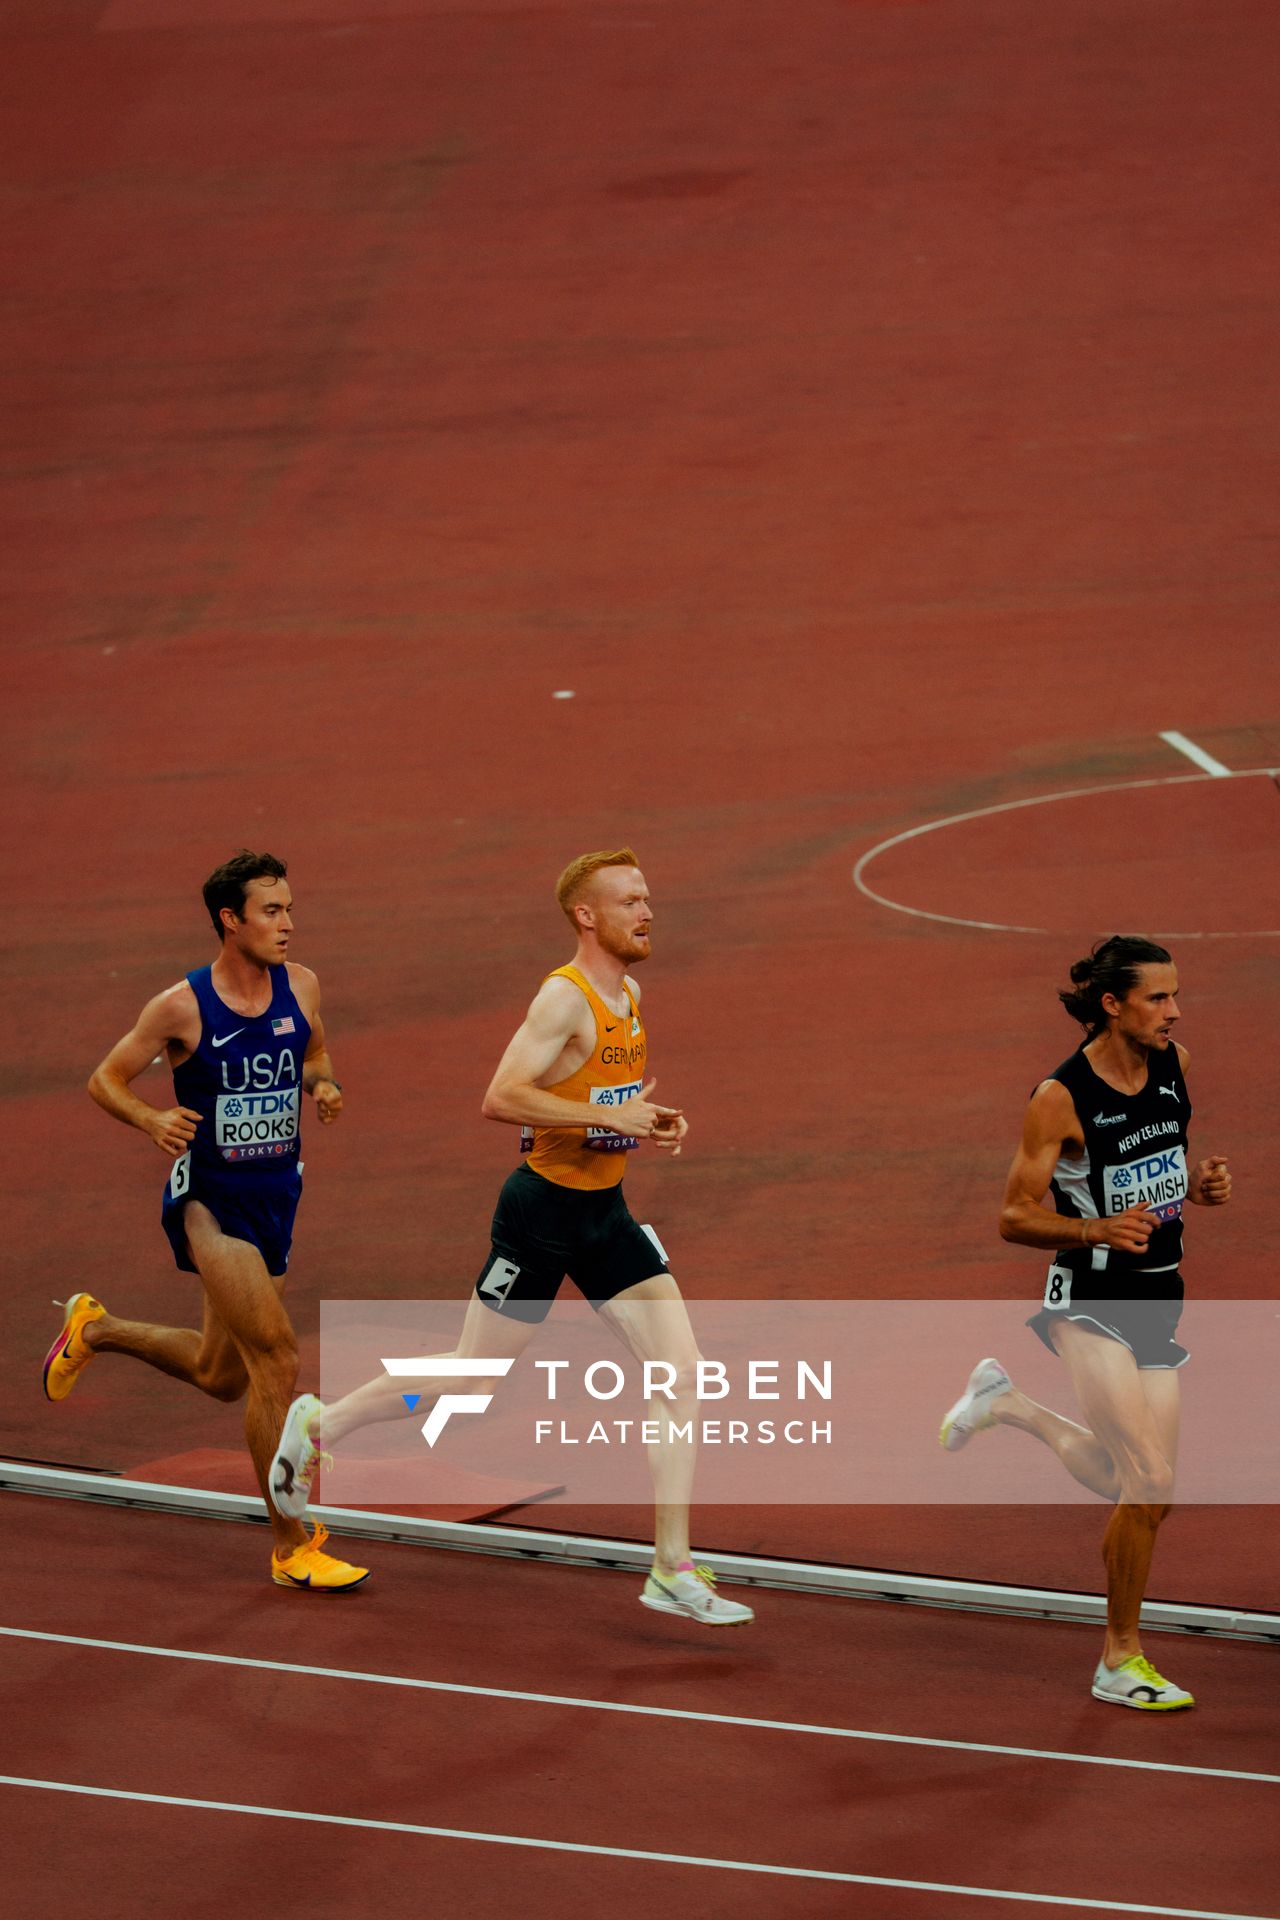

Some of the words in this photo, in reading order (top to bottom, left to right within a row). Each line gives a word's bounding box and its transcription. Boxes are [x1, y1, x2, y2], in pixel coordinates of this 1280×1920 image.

[221, 1048, 296, 1092] USA
[242, 1092, 295, 1116] TDK
[223, 1117, 295, 1143] ROOKS
[1118, 1130, 1141, 1154] NEW
[1140, 1120, 1180, 1141] ZEALAND
[176, 1160, 186, 1190] 5
[1130, 1150, 1181, 1183] TDK
[1111, 1174, 1186, 1213] BEAMISH
[1049, 1273, 1064, 1305] 8
